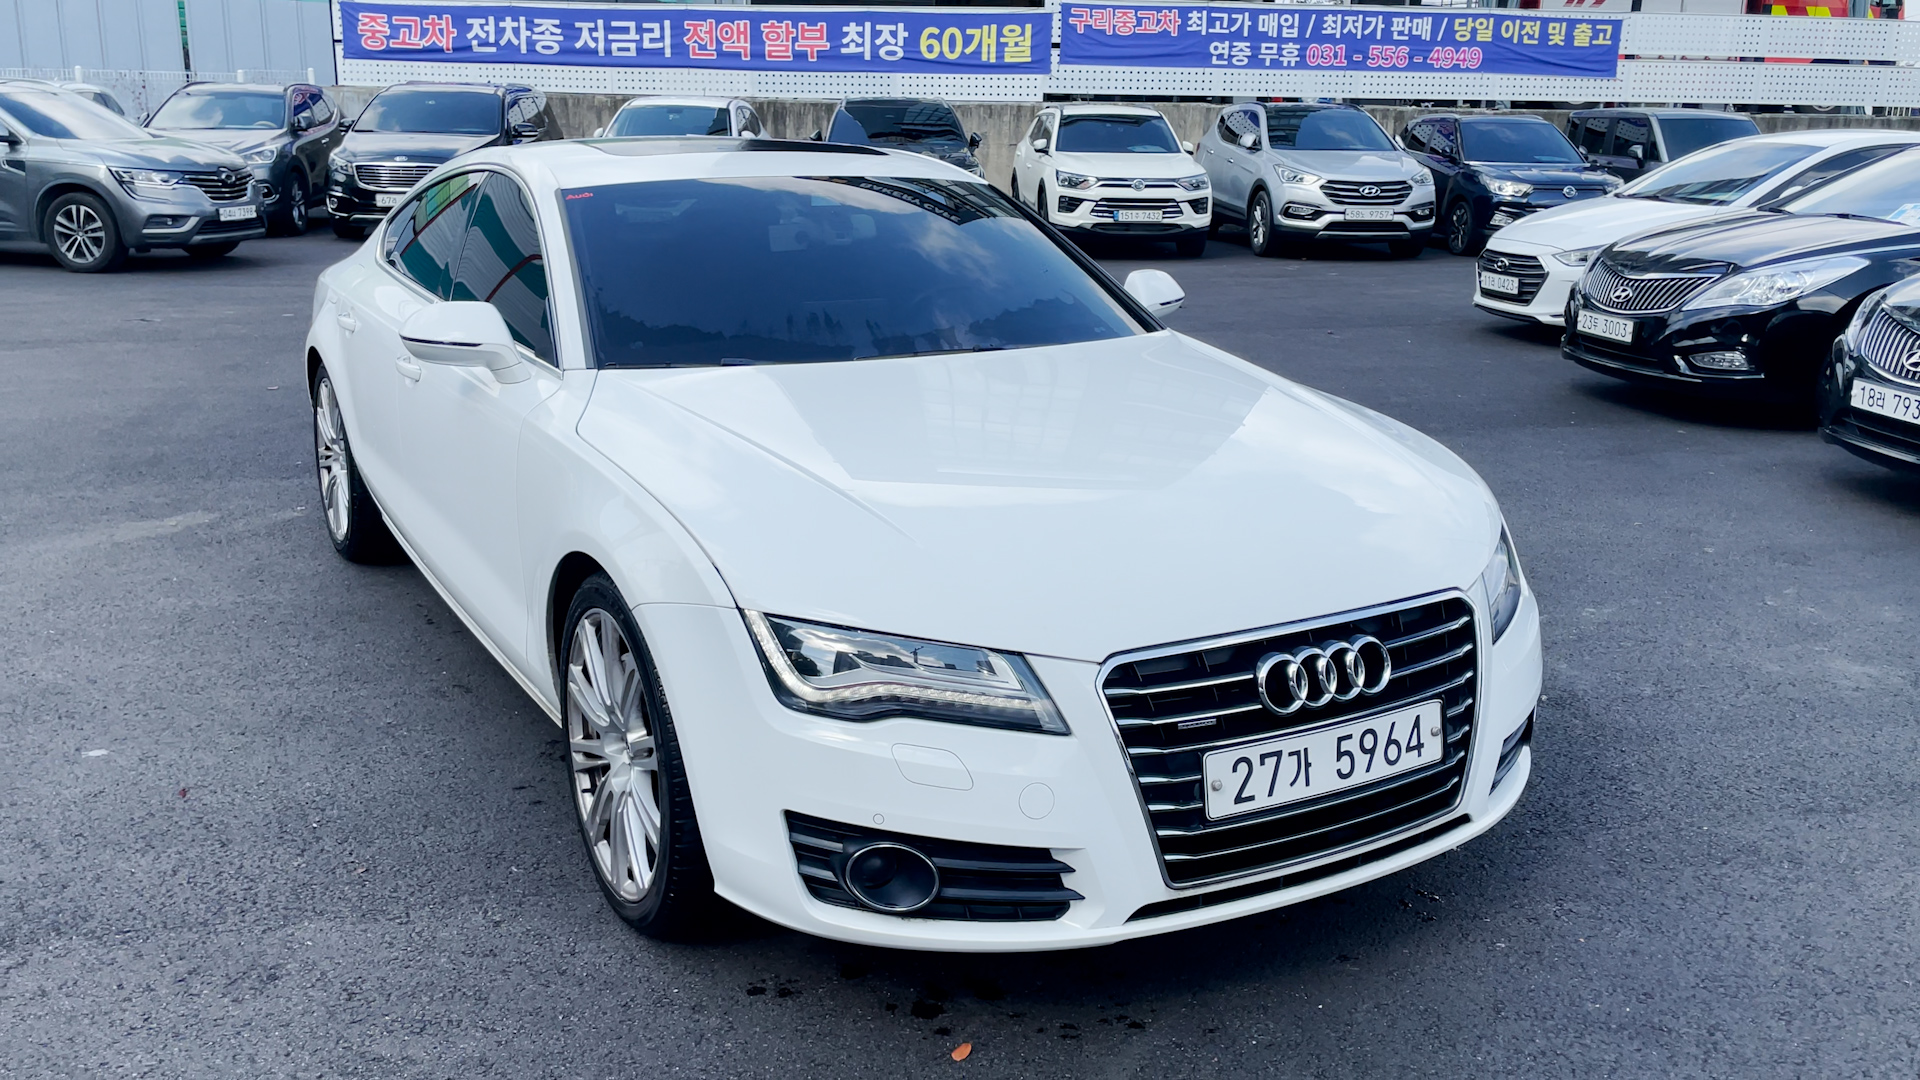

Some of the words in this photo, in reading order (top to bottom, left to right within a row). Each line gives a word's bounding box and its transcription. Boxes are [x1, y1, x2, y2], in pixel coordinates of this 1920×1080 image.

[357, 12, 457, 53] 중고차
[466, 15, 564, 56] 전차종
[574, 19, 672, 58] 저금리
[683, 19, 750, 60] 전액
[761, 20, 830, 61] 할부
[840, 22, 909, 62] 최장
[920, 23, 1033, 63] 60개월
[1069, 8, 1181, 36] 구리중고차
[1187, 10, 1252, 37] 최고가
[1258, 13, 1299, 38] 매입
[1305, 14, 1316, 38] /
[1322, 14, 1385, 40] 최저가
[1390, 16, 1432, 41] 판매
[1437, 17, 1448, 42] /
[1453, 17, 1494, 43] 당일
[1501, 19, 1540, 45] 이전
[1548, 22, 1566, 46] 및
[1572, 22, 1613, 47] 출고
[1209, 41, 1252, 66] 연중
[1258, 42, 1300, 67] 무휴
[1306, 43, 1347, 67] 031
[1366, 46, 1410, 68] 556
[1427, 46, 1483, 69] 4949
[1141, 211, 1161, 220] 7432
[1369, 210, 1390, 219] 9757
[1497, 277, 1515, 291] 0423
[1582, 314, 1598, 329] 23두
[1602, 319, 1627, 337] 3003
[1861, 386, 1885, 409] 18러
[1232, 747, 1312, 805] 27가
[1336, 714, 1425, 780] 5964
